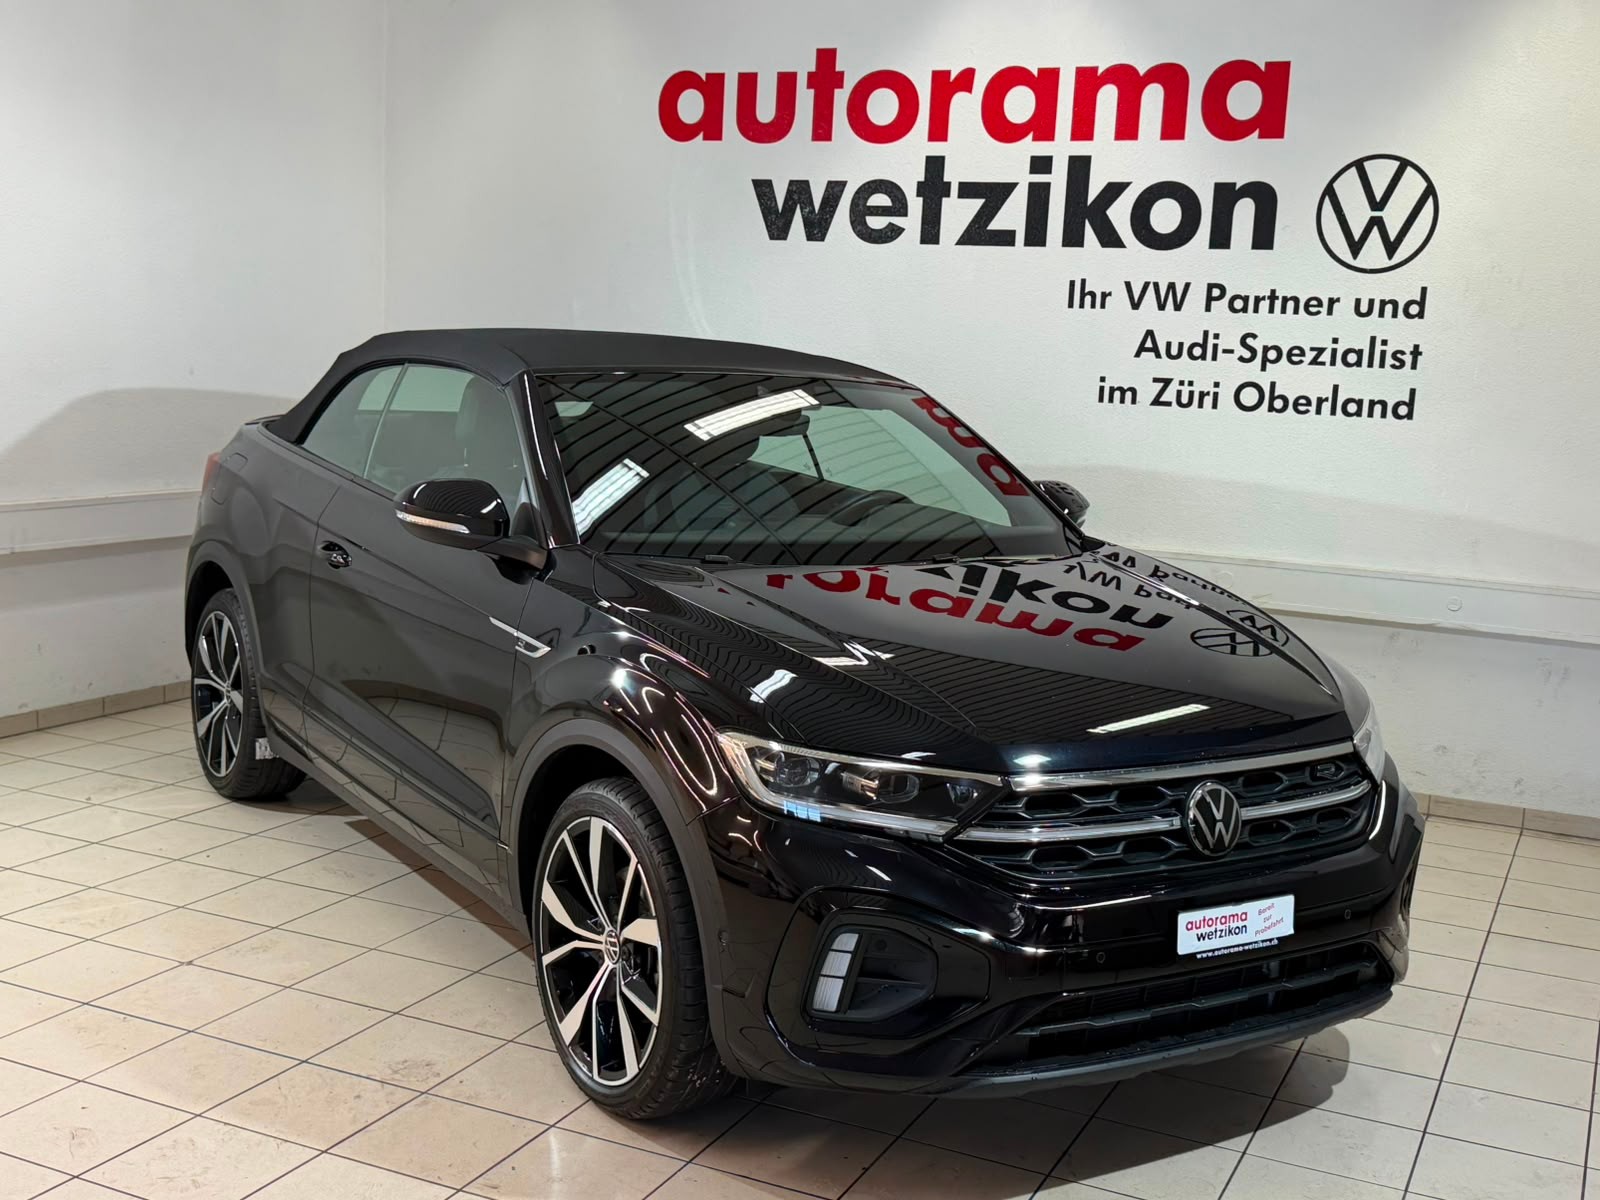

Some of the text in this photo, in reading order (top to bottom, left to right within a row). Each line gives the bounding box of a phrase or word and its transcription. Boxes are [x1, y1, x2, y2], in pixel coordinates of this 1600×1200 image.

[658, 47, 1291, 145] autorama
[751, 154, 1279, 251] wetzikon
[1067, 279, 1428, 320] Ihr VW Partner und
[1134, 329, 1423, 373] Audi-Spezialist
[1098, 376, 1417, 421] im Züri Oberland
[1185, 911, 1248, 932] autorama
[1257, 902, 1275, 916] Bereit
[1196, 924, 1248, 943] wetzikon
[1254, 917, 1285, 937] Probefahrt
[1195, 938, 1279, 960] www.autorama-wetzikon.ch
